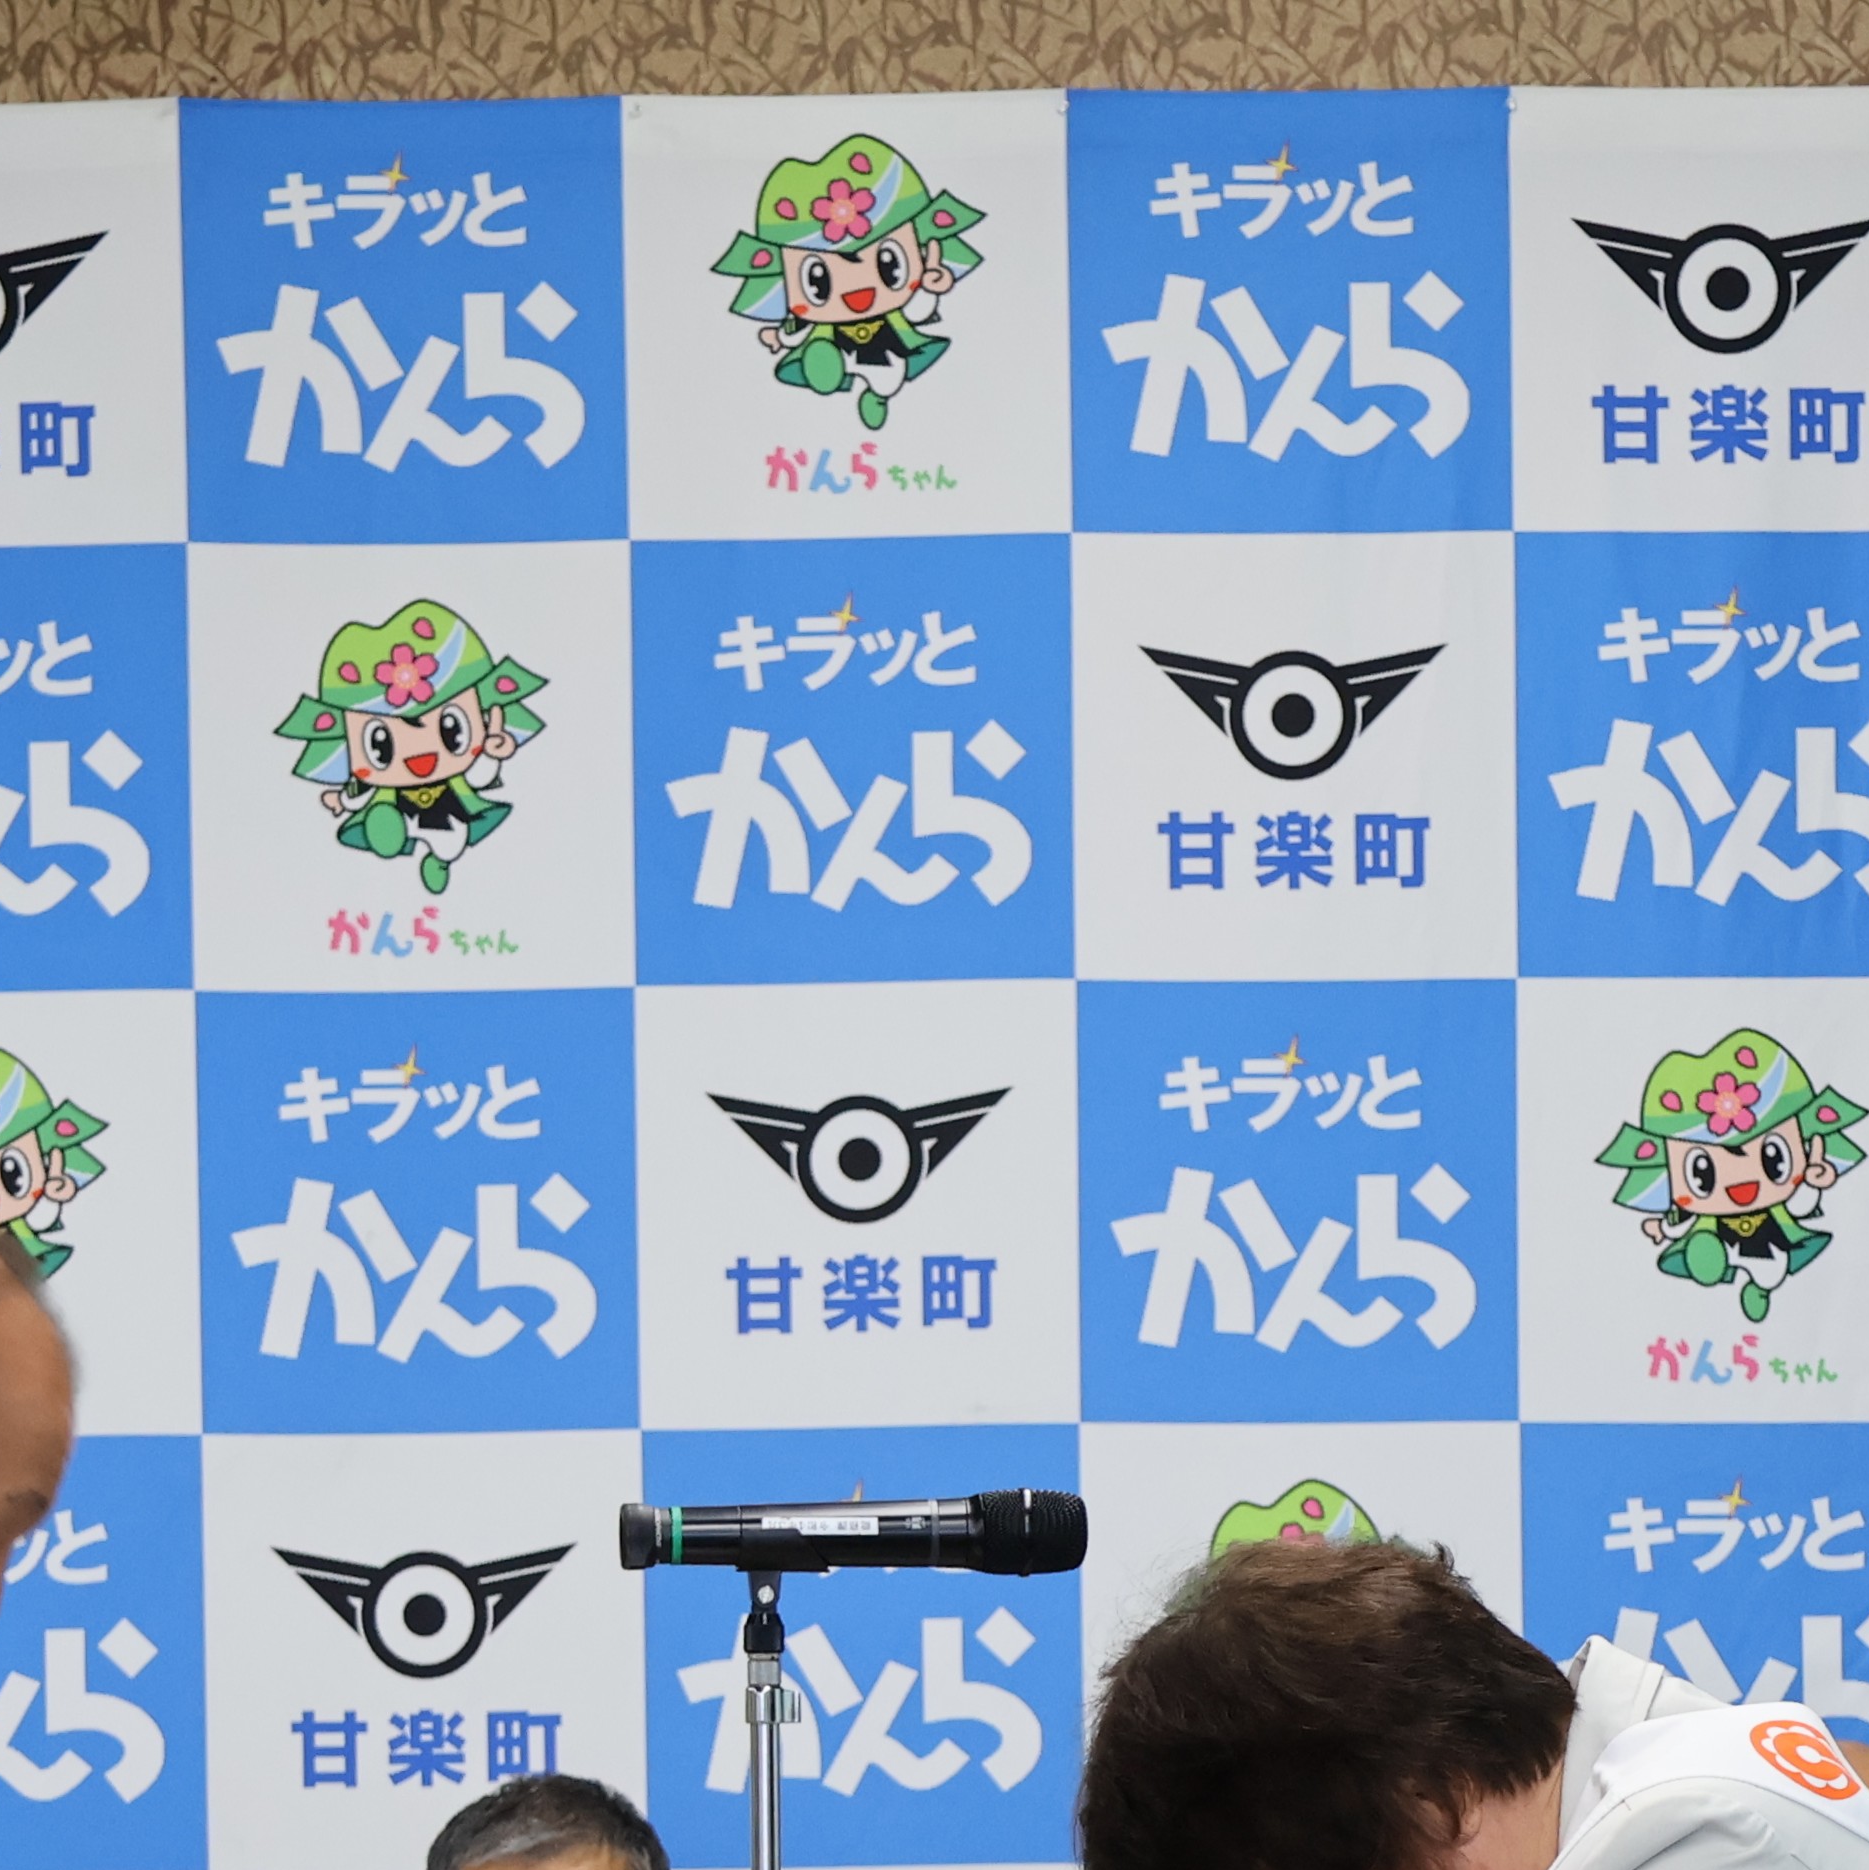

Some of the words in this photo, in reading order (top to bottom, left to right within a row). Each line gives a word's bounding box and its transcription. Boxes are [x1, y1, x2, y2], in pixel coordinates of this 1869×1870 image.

[264, 173, 527, 249] キラッと
[1150, 161, 1414, 238] キラッと
[217, 283, 586, 472] かんら
[1102, 271, 1470, 461] かんら
[1590, 383, 1867, 465] 甘楽町
[765, 441, 955, 494] かんらちゃん
[714, 611, 977, 691] キラッと
[1598, 605, 1860, 683] キラッと
[666, 720, 1032, 911] かんら
[1157, 809, 1432, 891] 甘楽町
[327, 906, 517, 958] かんらちゃん
[279, 1063, 541, 1142] キラッと
[1160, 1053, 1421, 1132] キラッと
[232, 1174, 597, 1363] かんら
[724, 1252, 999, 1335] 甘楽町
[1111, 1164, 1477, 1352] かんら
[1647, 1333, 1837, 1386] かんらちゃん
[3, 1509, 109, 1585] ッと
[1605, 1499, 1865, 1572] キラッと
[676, 1606, 1042, 1798] かんら
[290, 1708, 563, 1789] 甘楽町
